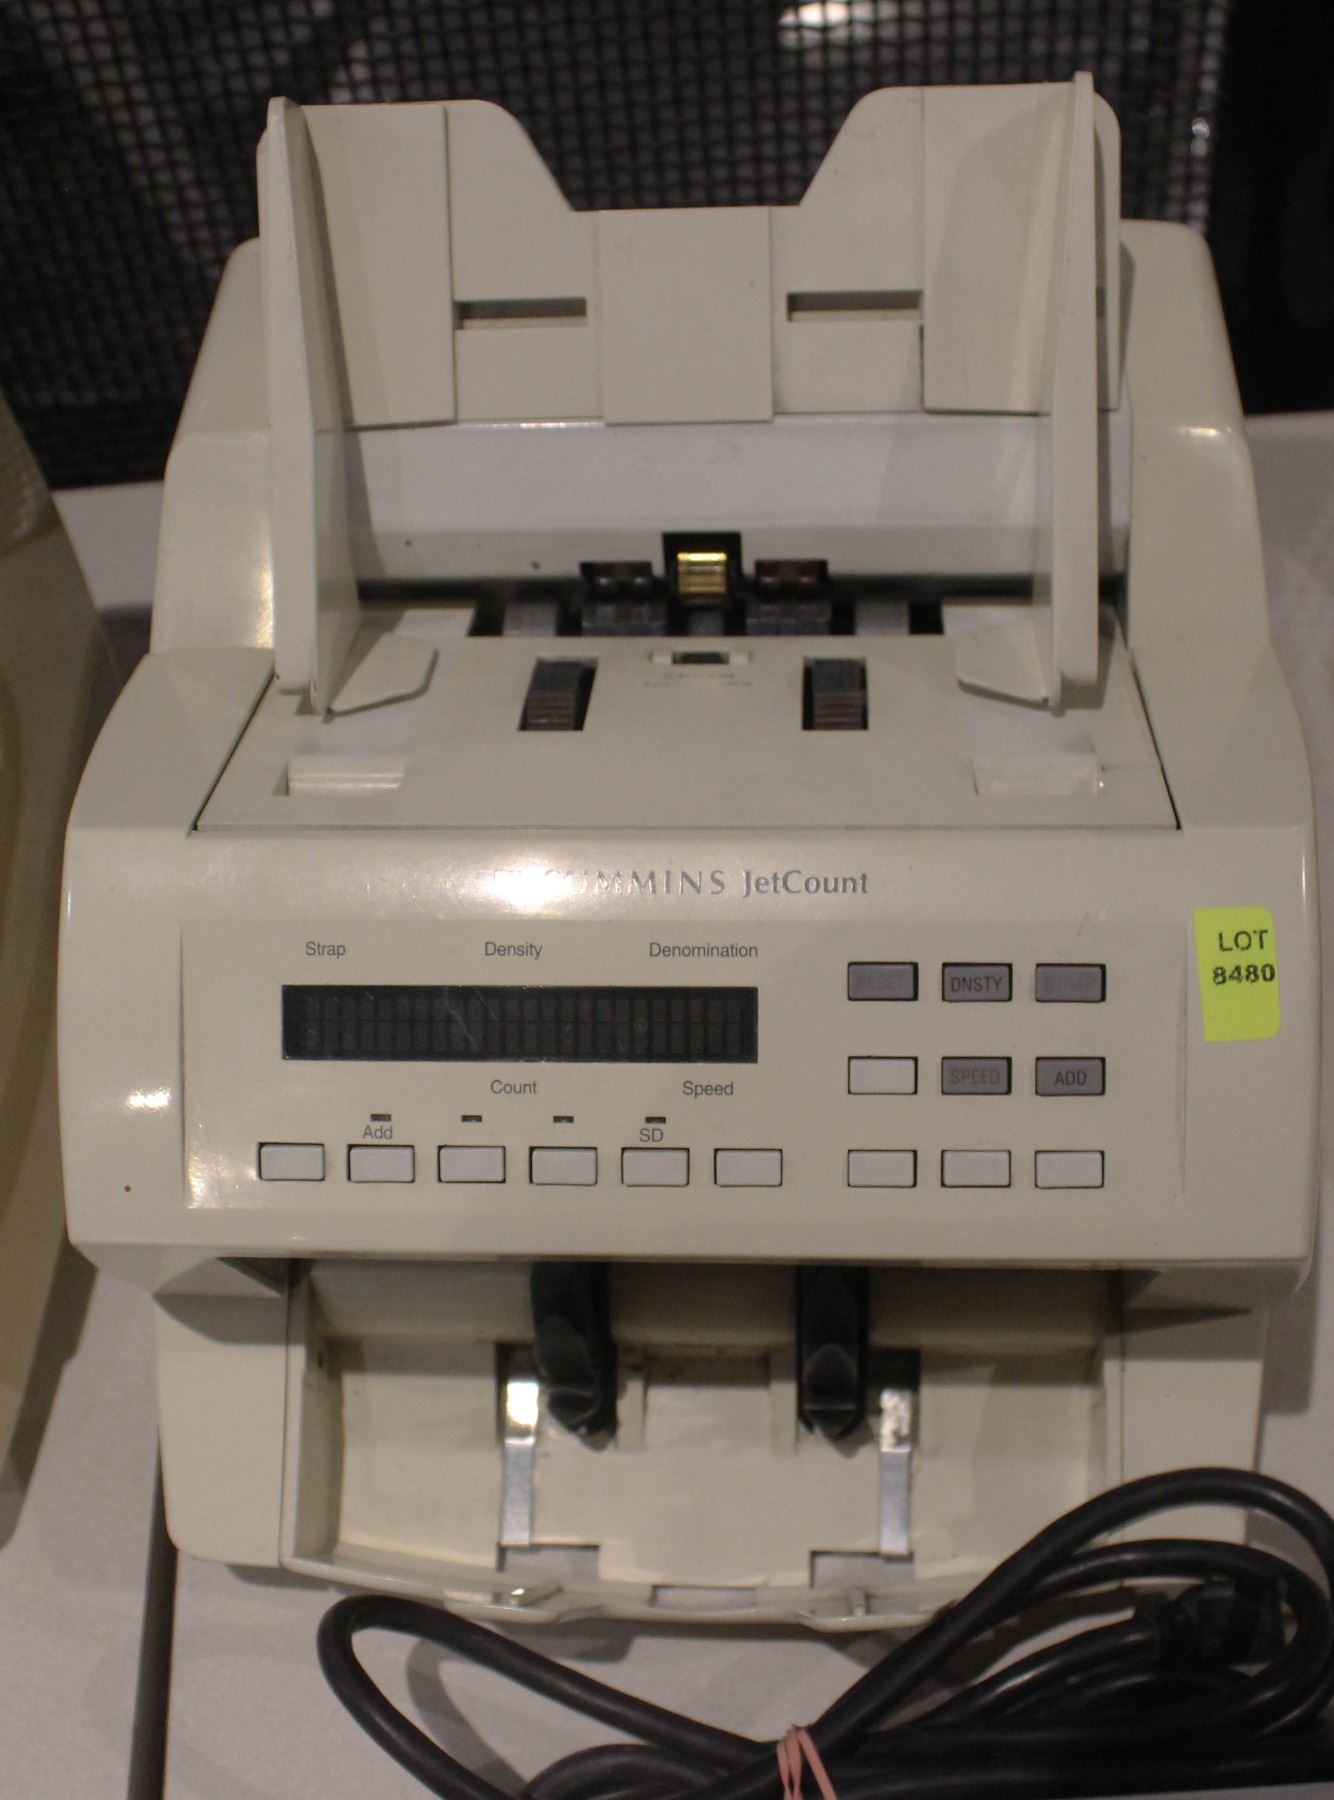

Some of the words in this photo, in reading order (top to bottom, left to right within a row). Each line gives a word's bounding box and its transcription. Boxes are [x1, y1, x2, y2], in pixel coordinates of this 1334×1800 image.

[743, 870, 869, 897] JetCount
[1218, 929, 1268, 952] LOT
[305, 941, 346, 959] Strap
[484, 941, 543, 960] Density
[648, 942, 758, 958] Denomination
[1212, 963, 1276, 986] 8480
[951, 975, 1002, 993] DNSTY
[950, 1069, 1000, 1085] SPEED
[1054, 1070, 1087, 1086] ADD
[490, 1079, 538, 1095] Count
[682, 1079, 734, 1099] Speed
[362, 1124, 394, 1140] Add
[639, 1127, 665, 1143] SD
